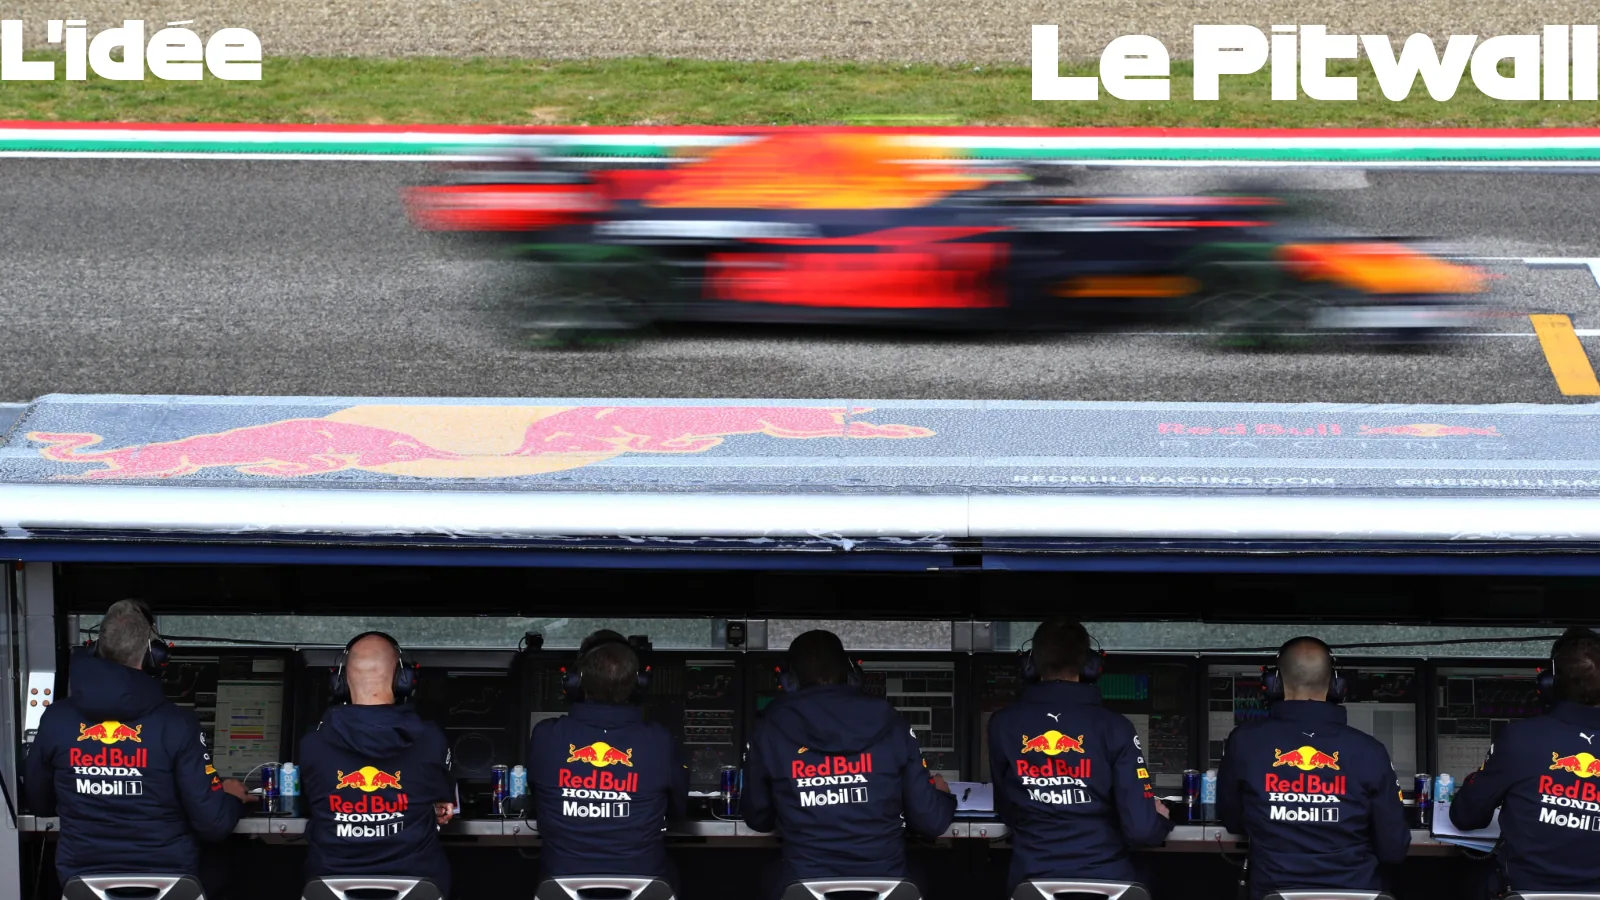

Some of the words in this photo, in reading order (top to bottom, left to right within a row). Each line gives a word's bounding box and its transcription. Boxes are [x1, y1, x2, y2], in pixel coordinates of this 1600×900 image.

[1158, 422, 1247, 436] Red
[1255, 423, 1342, 437] Bull
[69, 747, 107, 767] Red
[109, 747, 147, 768] Bull
[791, 755, 831, 779] Red
[833, 752, 873, 775] Bull
[74, 766, 143, 776] HONDA
[1016, 757, 1054, 778] Red
[1055, 758, 1091, 779] Bull
[76, 778, 123, 796] Mobil
[558, 768, 598, 790] Red
[599, 770, 639, 793] Bull
[796, 774, 868, 788] HONDA
[1021, 775, 1087, 788] HONDA
[1264, 772, 1305, 793] Red
[1306, 774, 1346, 796] Bull
[1538, 774, 1581, 799] Red
[562, 788, 632, 801] HONDA
[800, 788, 849, 807] Mobil
[1027, 788, 1073, 805] Mobil
[1268, 793, 1341, 804] HONDA
[1540, 793, 1600, 813] HOND
[329, 794, 368, 814] Red
[370, 793, 409, 814] Bull
[562, 801, 611, 818] Mobil
[334, 811, 404, 823] HONDA
[1269, 805, 1320, 822] Mobil
[1538, 806, 1591, 831] Mobil
[336, 823, 385, 838] Mobil
